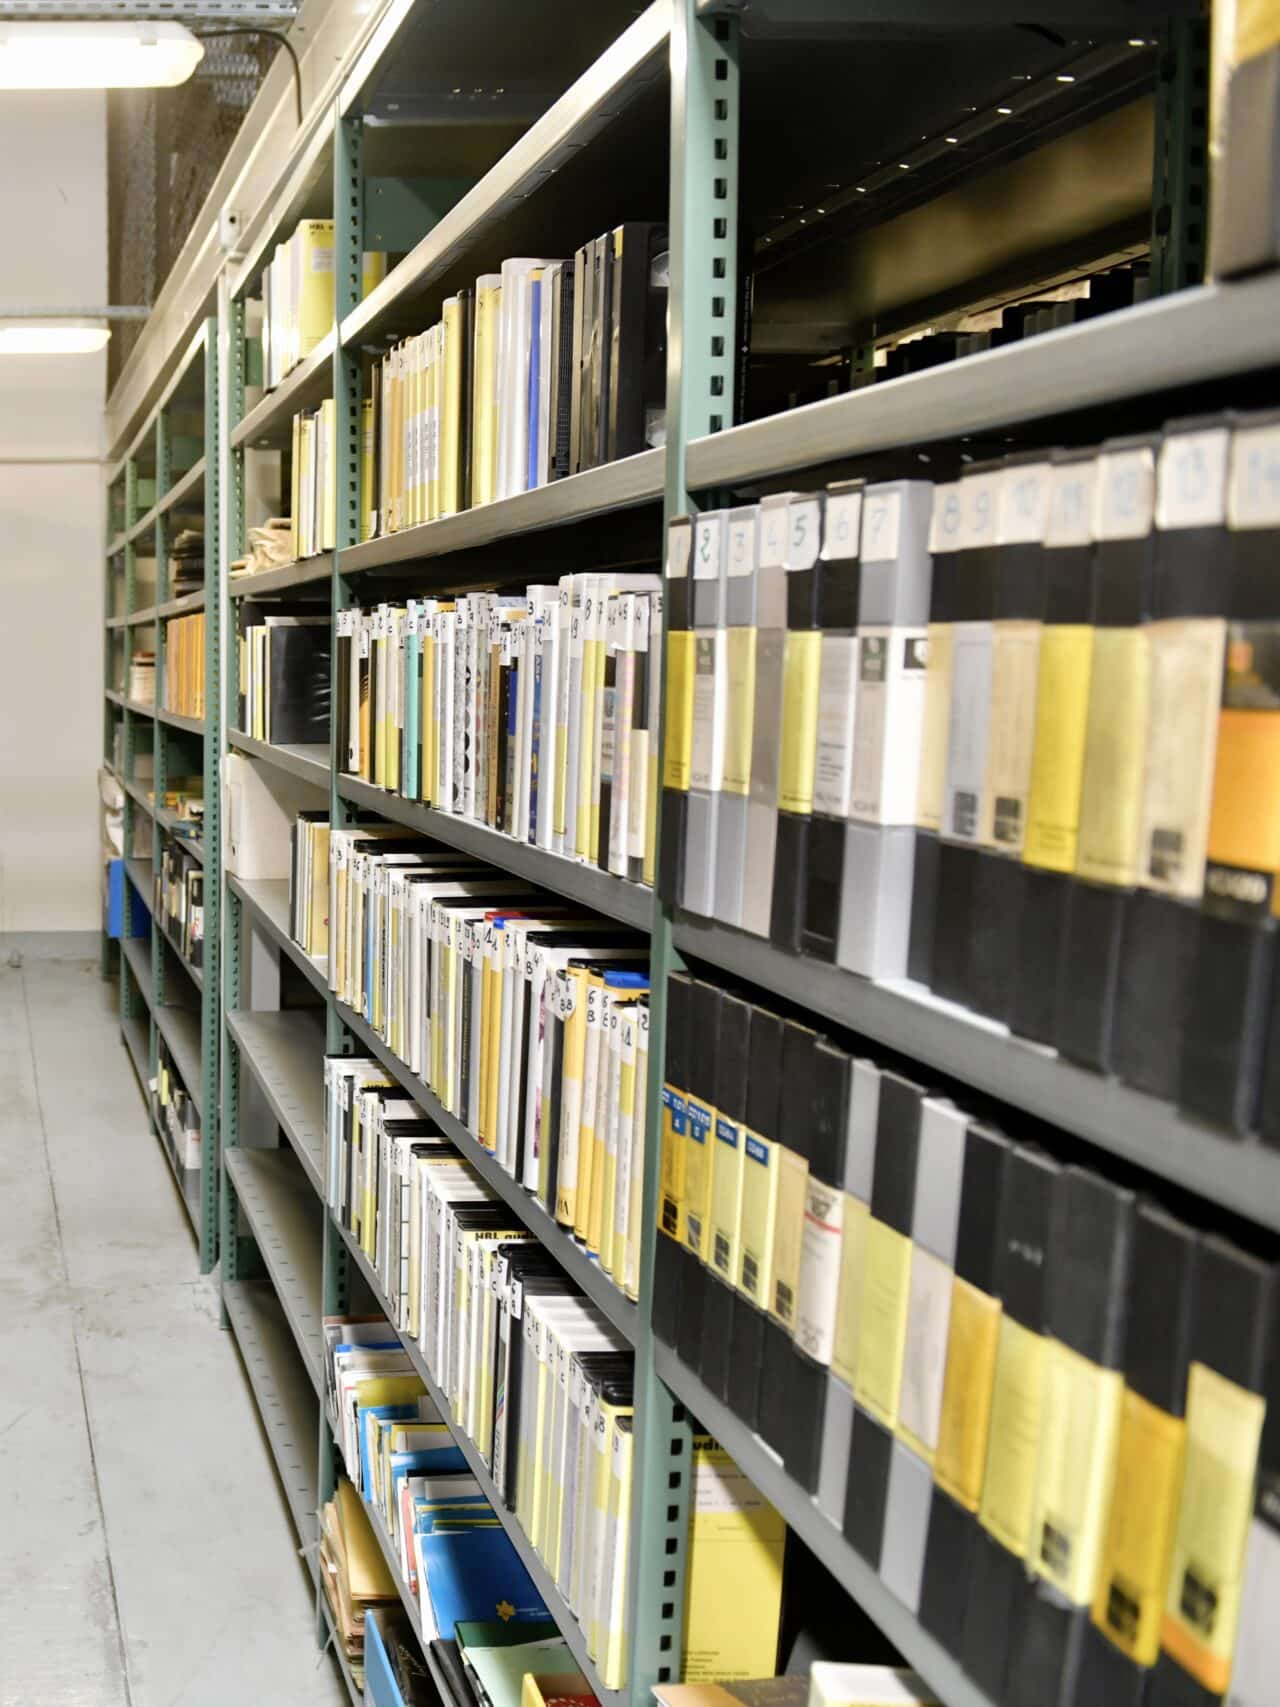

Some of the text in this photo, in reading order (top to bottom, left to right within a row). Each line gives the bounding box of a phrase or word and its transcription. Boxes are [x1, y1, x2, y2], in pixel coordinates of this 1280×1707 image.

[793, 514, 807, 547] 5
[870, 508, 888, 541] 7
[943, 494, 960, 534] 8
[700, 527, 711, 563] 2
[528, 602, 534, 615] 3
